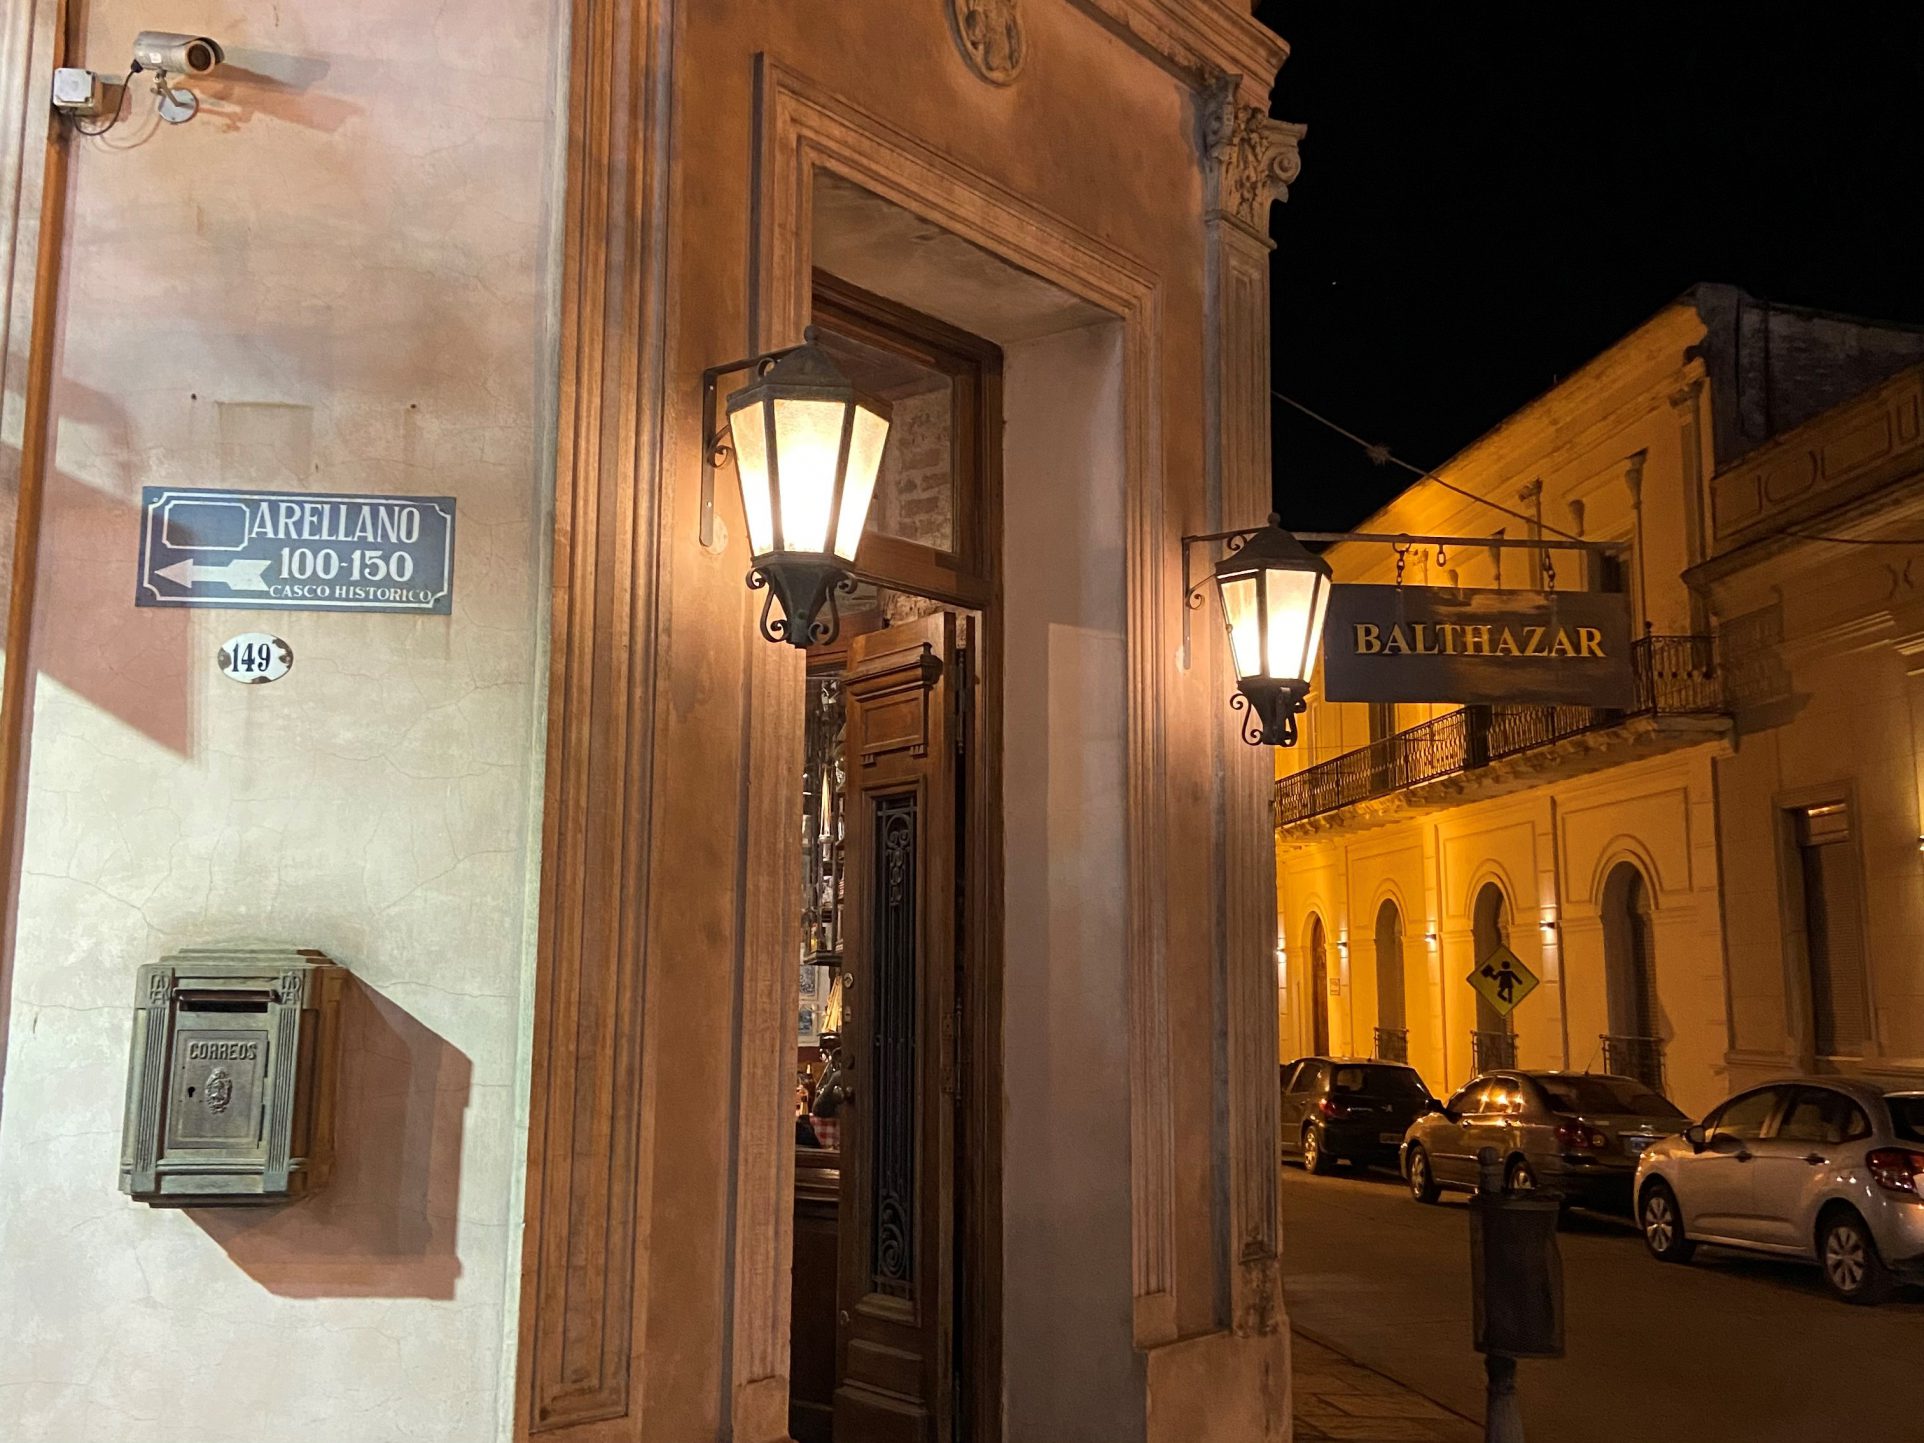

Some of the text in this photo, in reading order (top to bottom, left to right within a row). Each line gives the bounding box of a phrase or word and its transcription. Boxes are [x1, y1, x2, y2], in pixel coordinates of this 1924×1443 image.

[248, 501, 420, 543] ARELLANO
[279, 547, 414, 582] 100-150
[269, 584, 432, 602] CASCO HISTORICO
[1354, 622, 1606, 657] BALTHAZAR
[231, 643, 271, 672] 149
[189, 1042, 257, 1060] CORREOS
